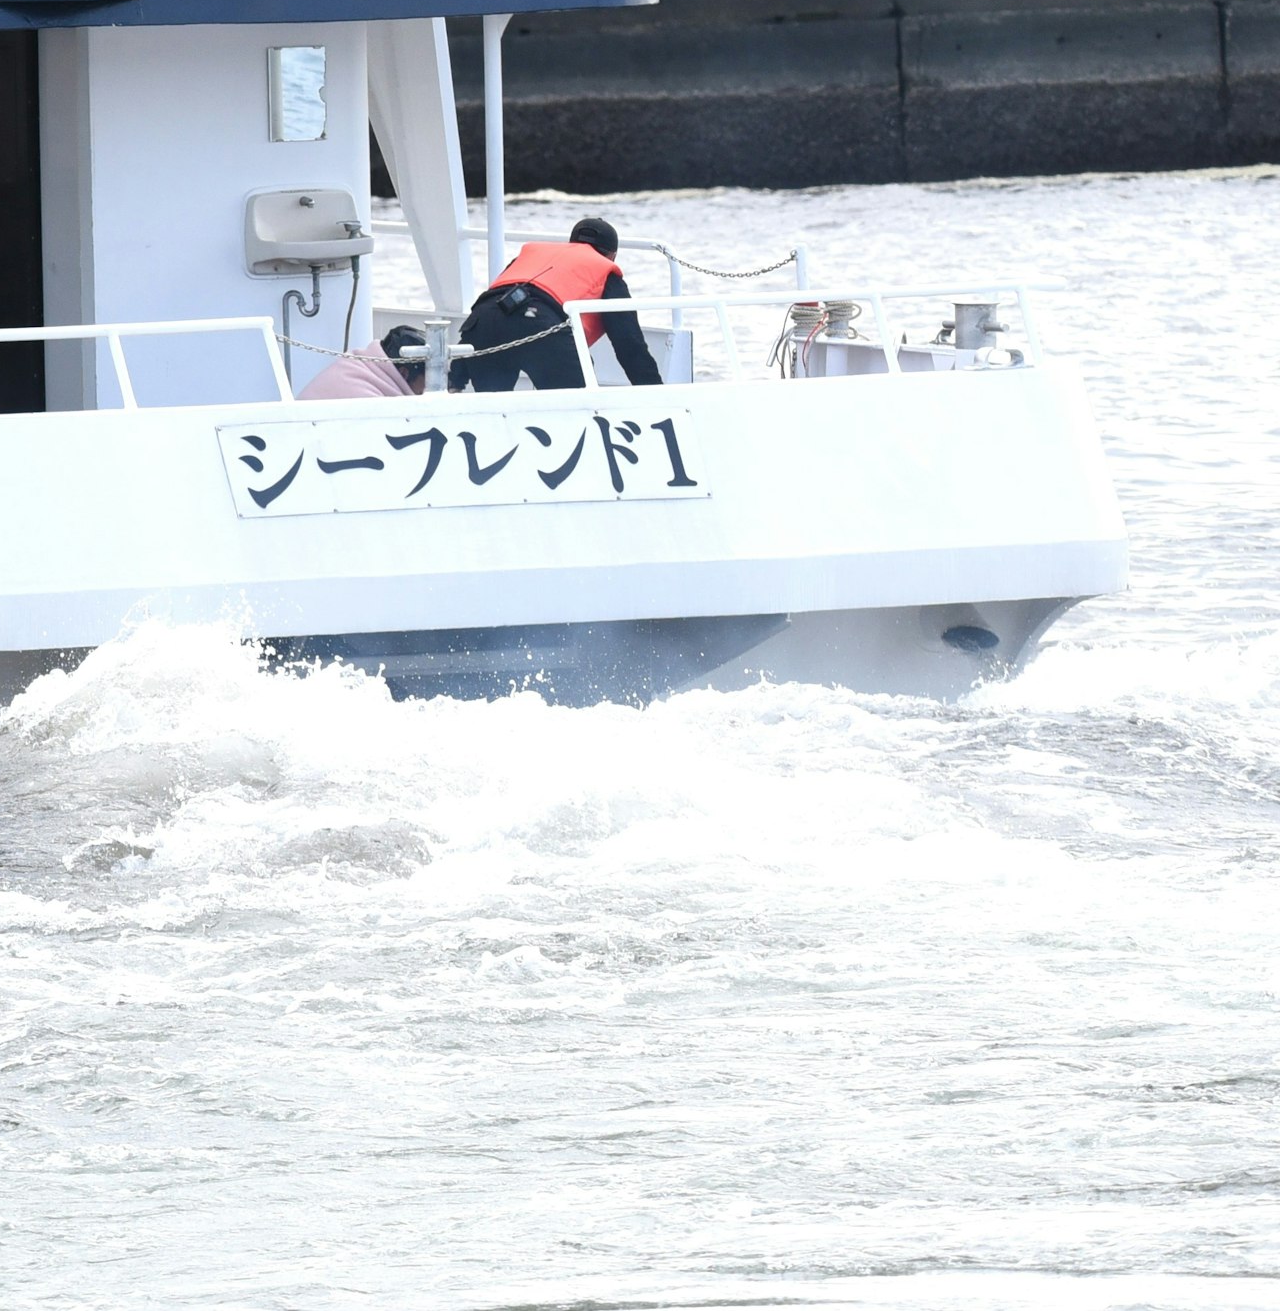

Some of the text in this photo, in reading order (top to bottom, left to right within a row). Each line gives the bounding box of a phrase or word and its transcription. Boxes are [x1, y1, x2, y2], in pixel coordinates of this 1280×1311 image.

[238, 416, 697, 508] シーフレンド1
